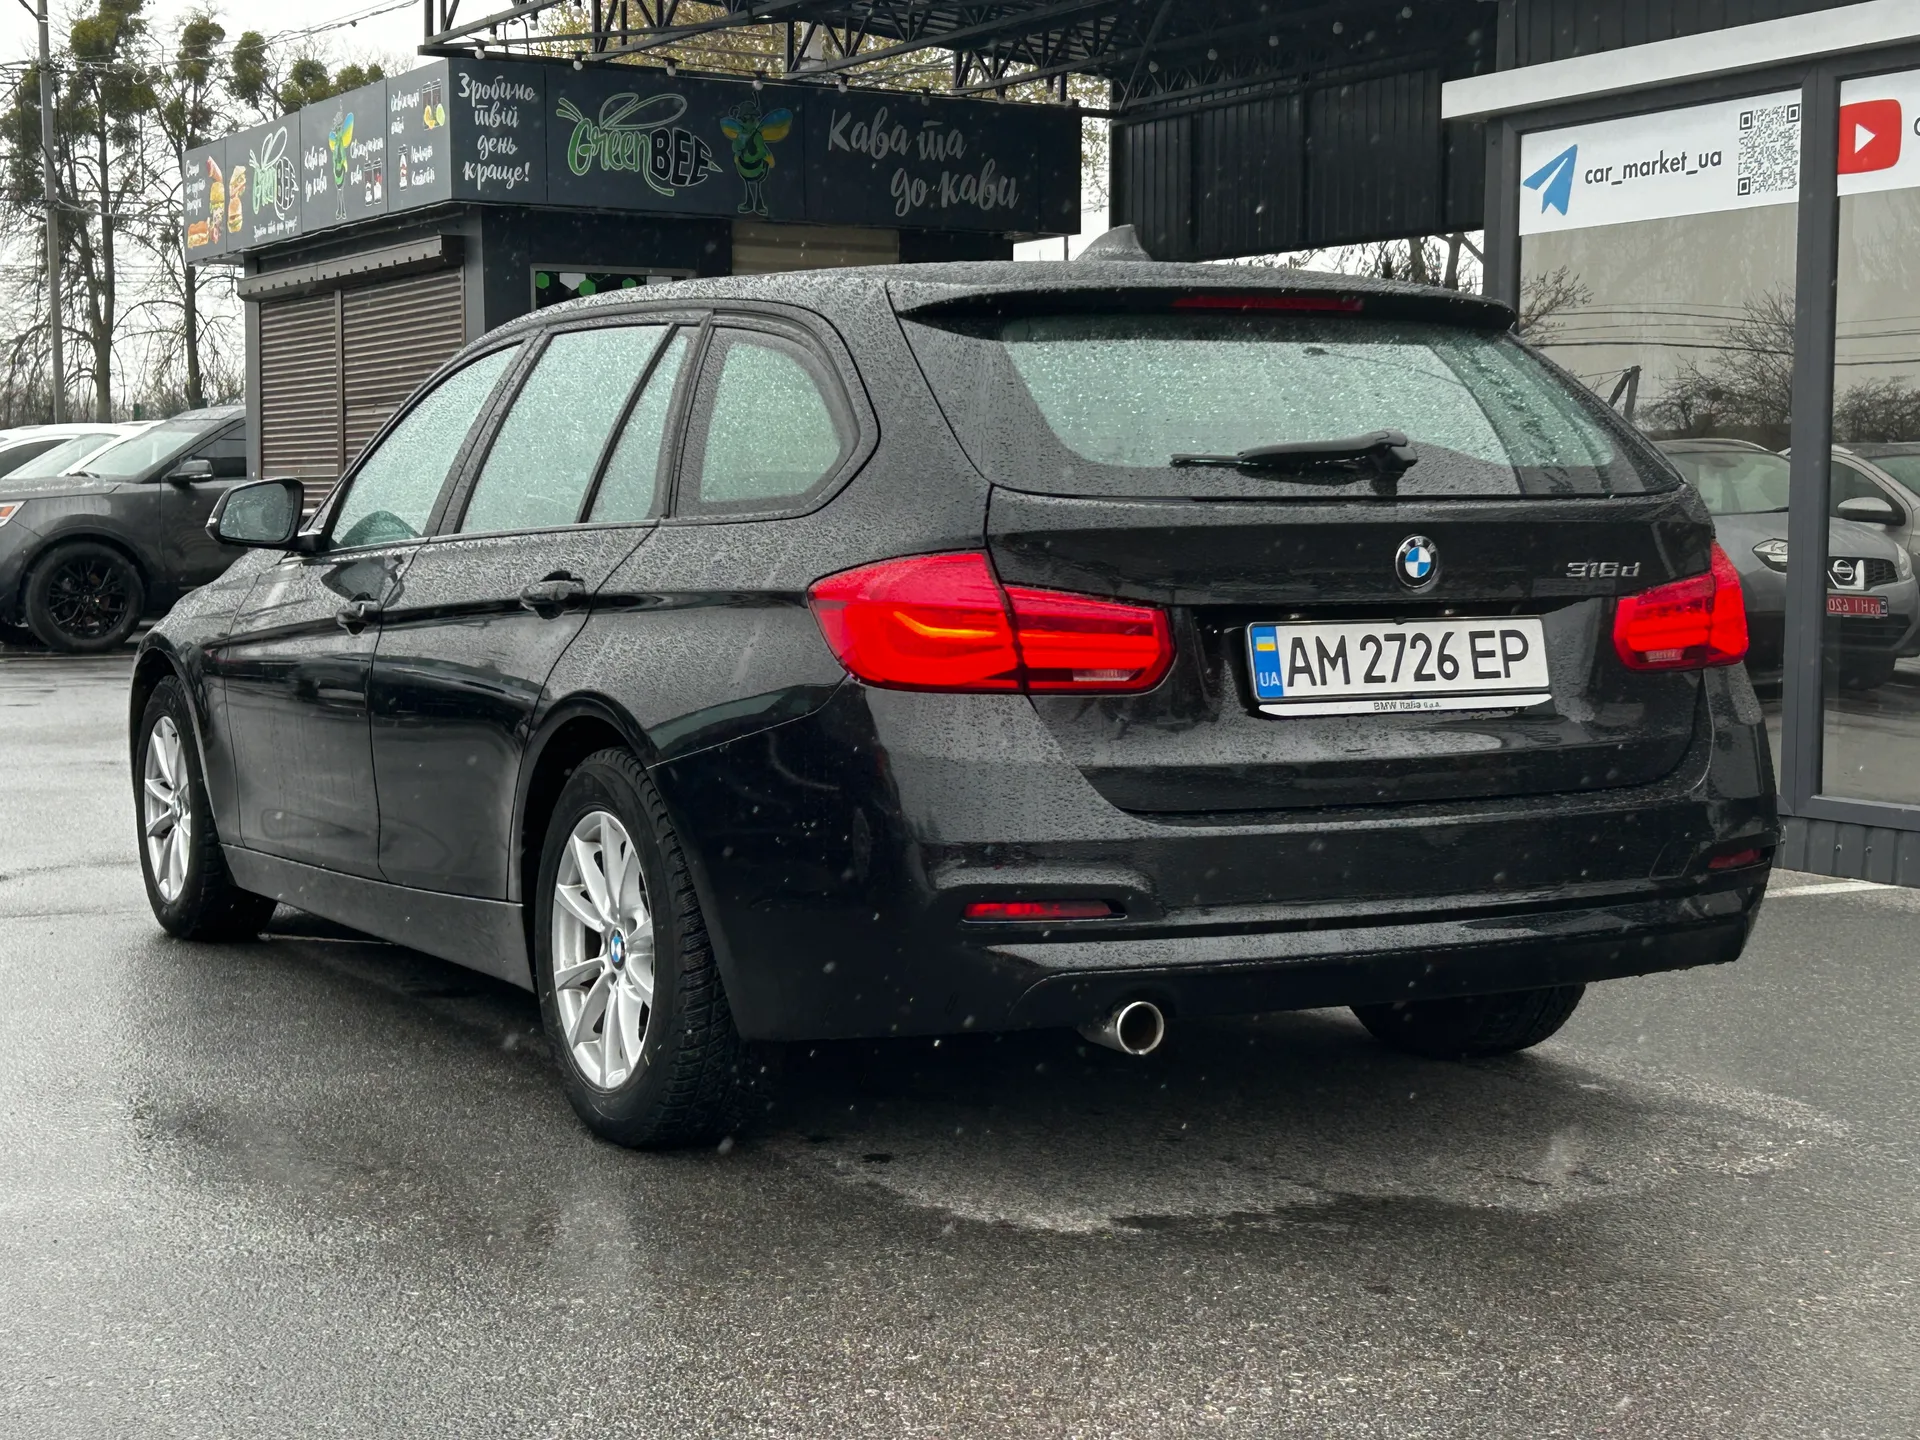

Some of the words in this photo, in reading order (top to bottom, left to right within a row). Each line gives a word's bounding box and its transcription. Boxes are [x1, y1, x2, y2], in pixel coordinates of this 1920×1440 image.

[458, 72, 536, 108] Зробимо
[474, 101, 519, 128] твій
[477, 135, 518, 160] день
[828, 106, 912, 160] Кава
[917, 120, 967, 162] та
[462, 161, 530, 191] краще!
[1584, 149, 1723, 186] car_market_ua
[890, 167, 928, 217] до
[936, 158, 1019, 211] кави
[1565, 562, 1641, 578] 316d
[1287, 634, 1351, 687] AM
[1359, 631, 1460, 684] 2726
[1468, 629, 1530, 680] EP
[1259, 671, 1280, 687] UA
[1373, 701, 1397, 711] BMW
[1399, 701, 1421, 710] Italia
